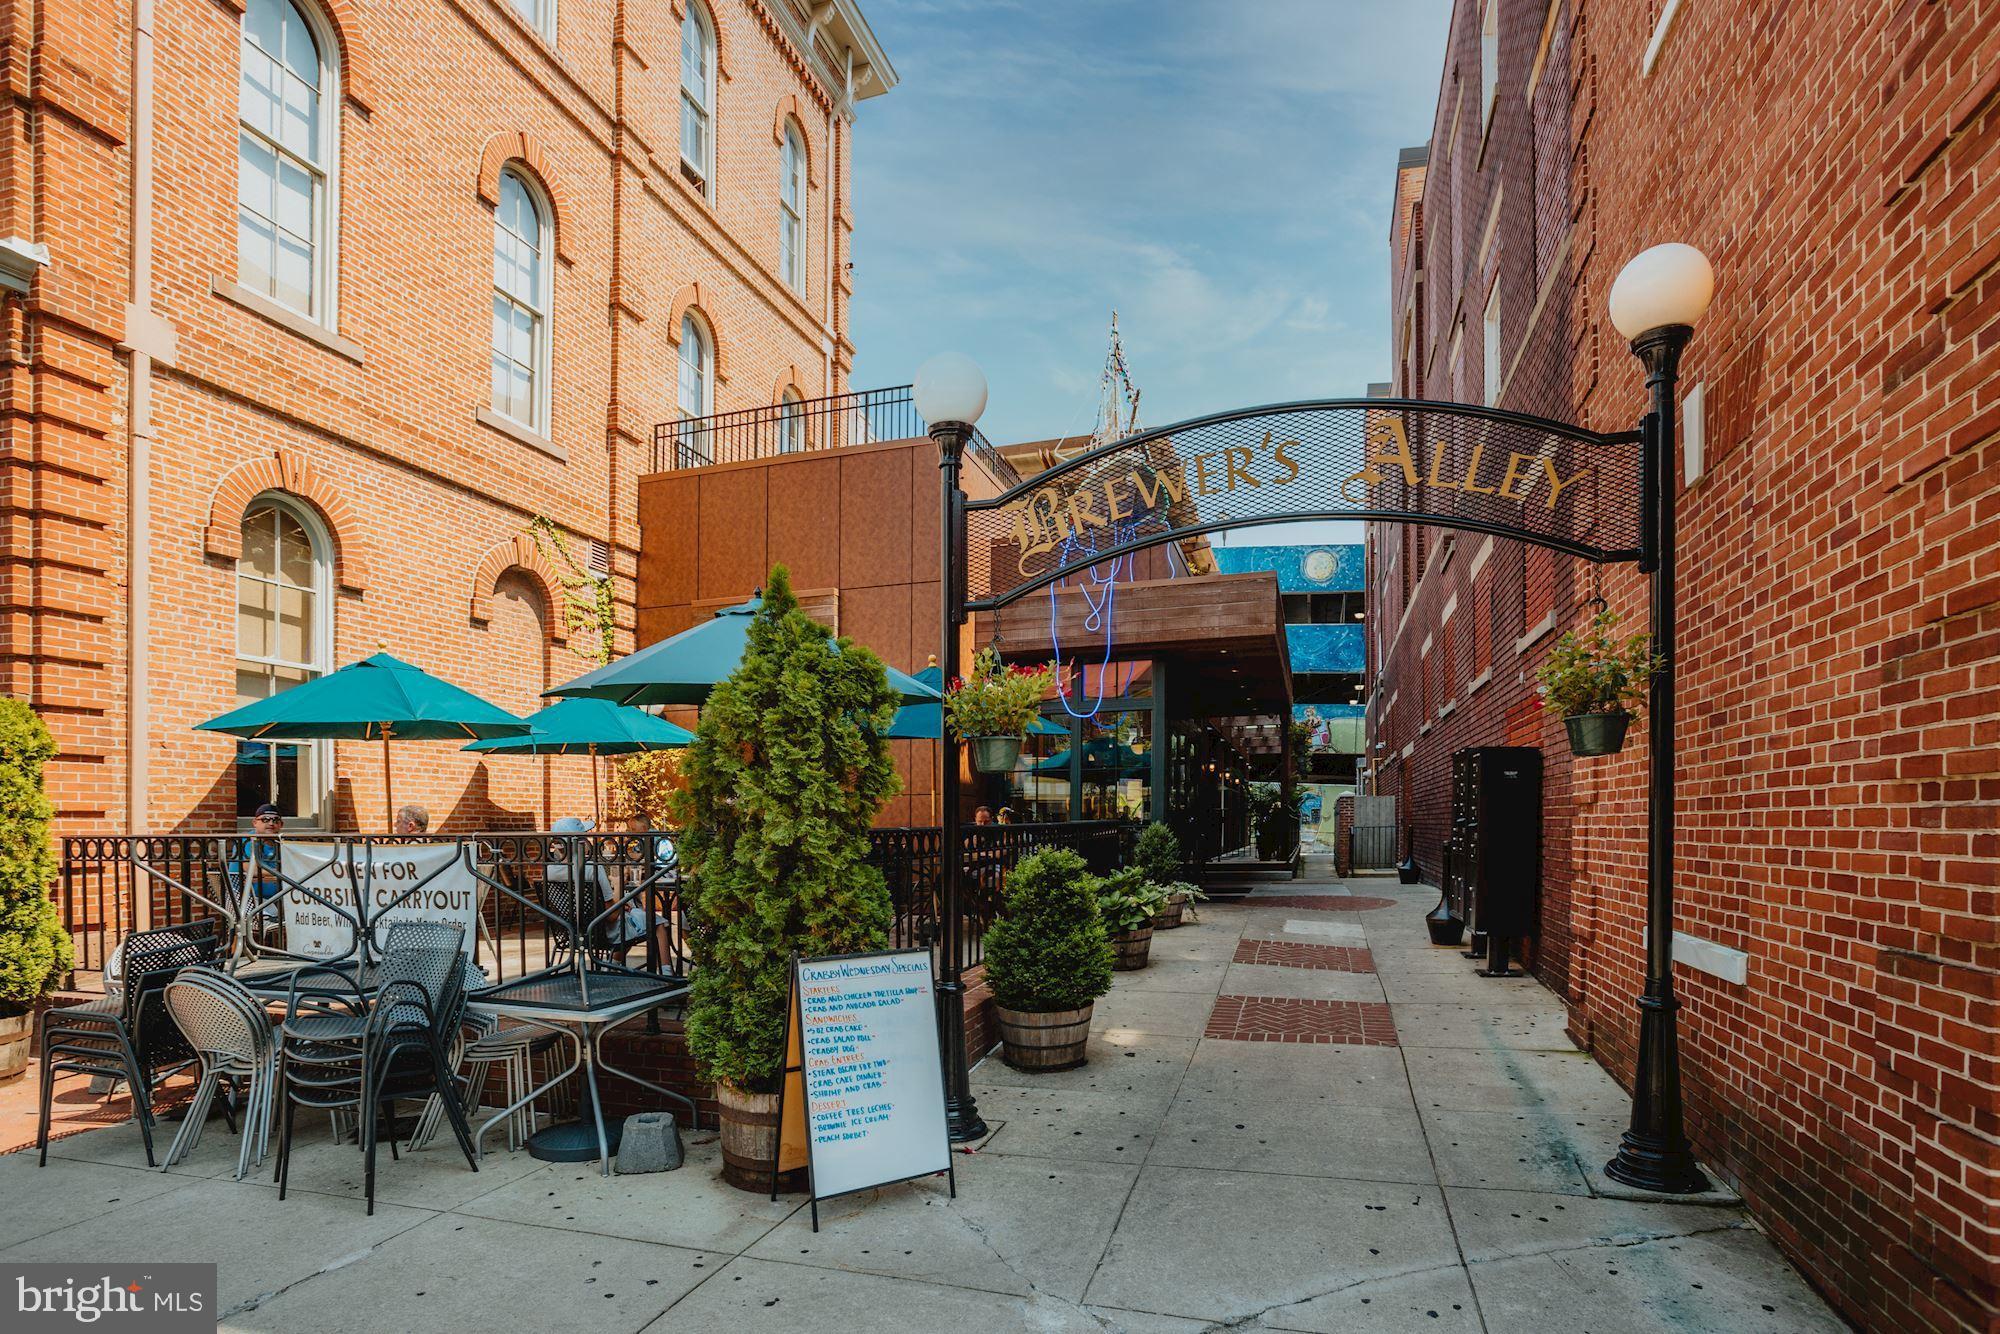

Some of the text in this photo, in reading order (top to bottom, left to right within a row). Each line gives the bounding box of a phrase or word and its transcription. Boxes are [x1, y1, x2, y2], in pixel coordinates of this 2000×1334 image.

[1000, 417, 1592, 577] BREWER'S ALLEY
[382, 862, 418, 880] FOR
[291, 887, 471, 911] CURBSI CARRYOUT
[295, 912, 310, 926] Add
[312, 913, 333, 928] Beer,
[335, 914, 352, 928] Win
[802, 968, 841, 981] CRABBY
[891, 957, 928, 975] SPECIALS
[802, 985, 840, 996] STARTERS
[807, 996, 826, 1004] CRAB
[828, 995, 843, 1003] AND
[844, 992, 872, 1001] CHICKEN
[874, 989, 904, 998] TORTILLA
[808, 997, 900, 1013] CRAB AND AVOCADO SALAD
[805, 1014, 857, 1025] SANDWICHES
[845, 1024, 863, 1032] CAKE
[811, 1034, 871, 1045] CRAB SALAD ROLL
[811, 1046, 838, 1055] CRABBY
[812, 1067, 835, 1078] STEAK
[859, 1062, 871, 1071] FOR
[873, 1059, 887, 1067] TWO
[813, 1072, 882, 1088] CRAB CAKE DINNER
[813, 1081, 882, 1099] SHRIMP AND CRAB
[816, 1103, 892, 1121] COFFEE TRES LECHES
[817, 1113, 889, 1132] BROWNIE ICE CREAM
[818, 1130, 866, 1143] PEACH SORBET
